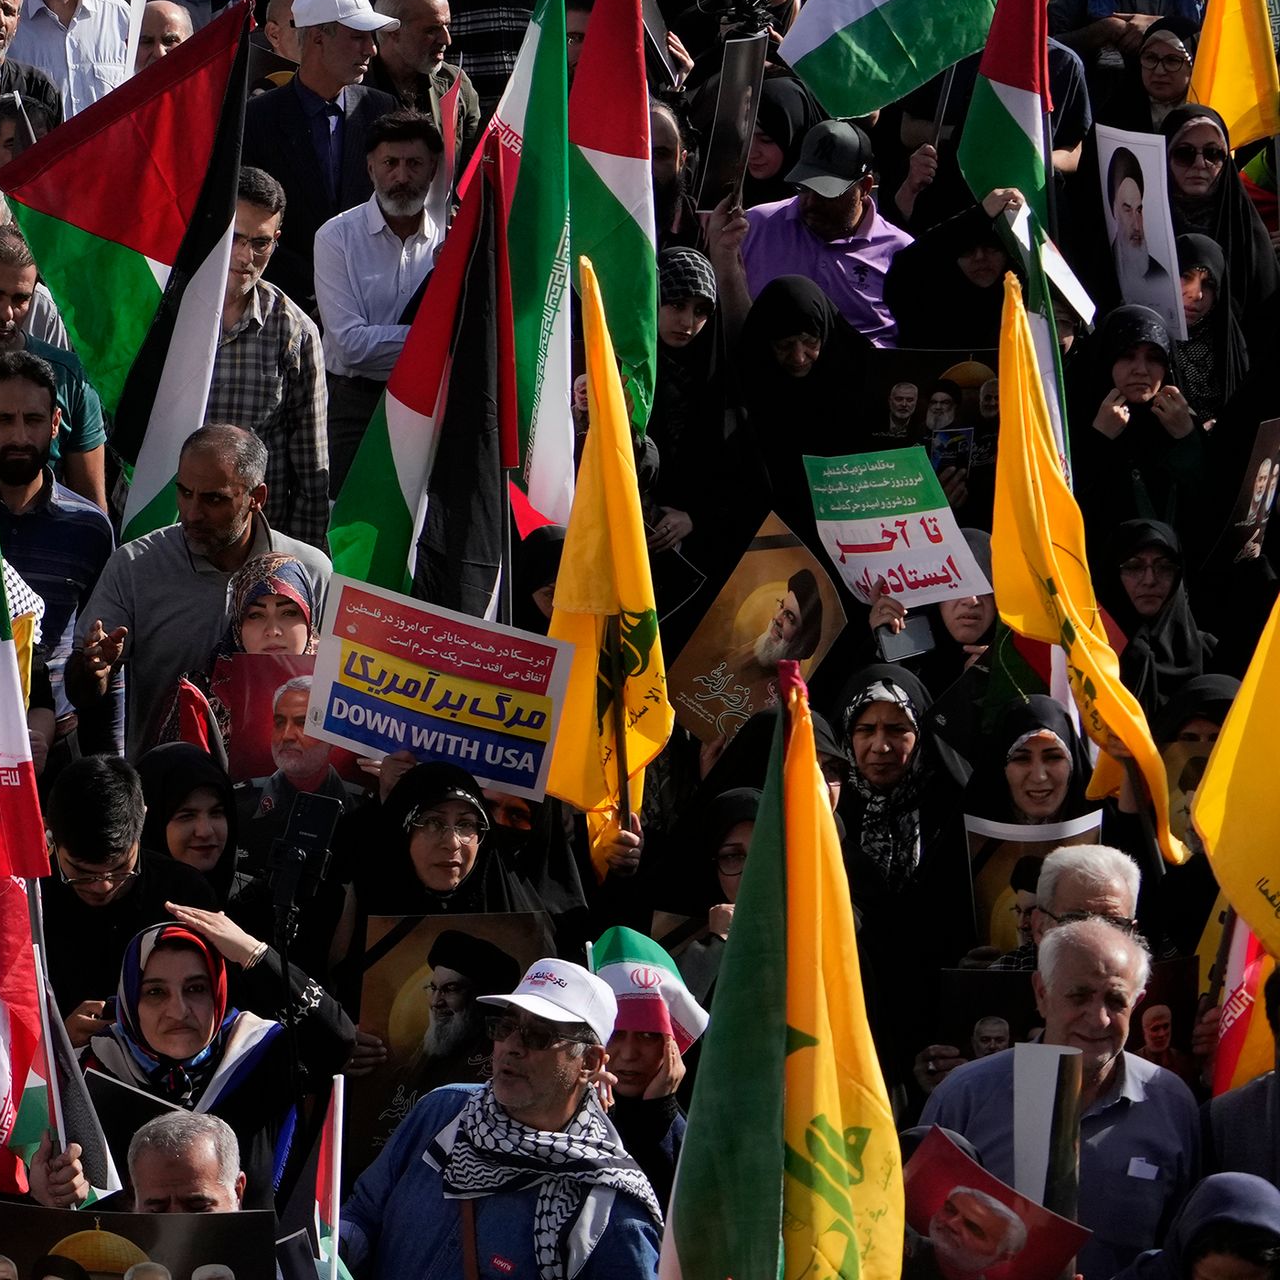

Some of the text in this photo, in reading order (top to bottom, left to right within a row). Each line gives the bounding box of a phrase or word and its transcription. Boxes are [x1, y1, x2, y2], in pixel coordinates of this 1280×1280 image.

[920, 516, 944, 544] تا
[836, 519, 912, 565] آخر
[345, 601, 382, 620] فلسطین
[380, 613, 394, 624] در
[395, 618, 420, 634] امروز
[420, 623, 434, 635] که
[432, 632, 470, 648] جنایاتی
[471, 640, 496, 654] همه
[412, 642, 439, 659] جرم
[497, 644, 511, 658] در
[440, 651, 483, 671] شریک
[483, 660, 503, 674] افتد
[503, 670, 520, 682] می
[526, 671, 547, 685] اتفاق
[343, 650, 548, 731] مرگ بر آمریکا
[331, 696, 536, 773] DOWN WITH USA
